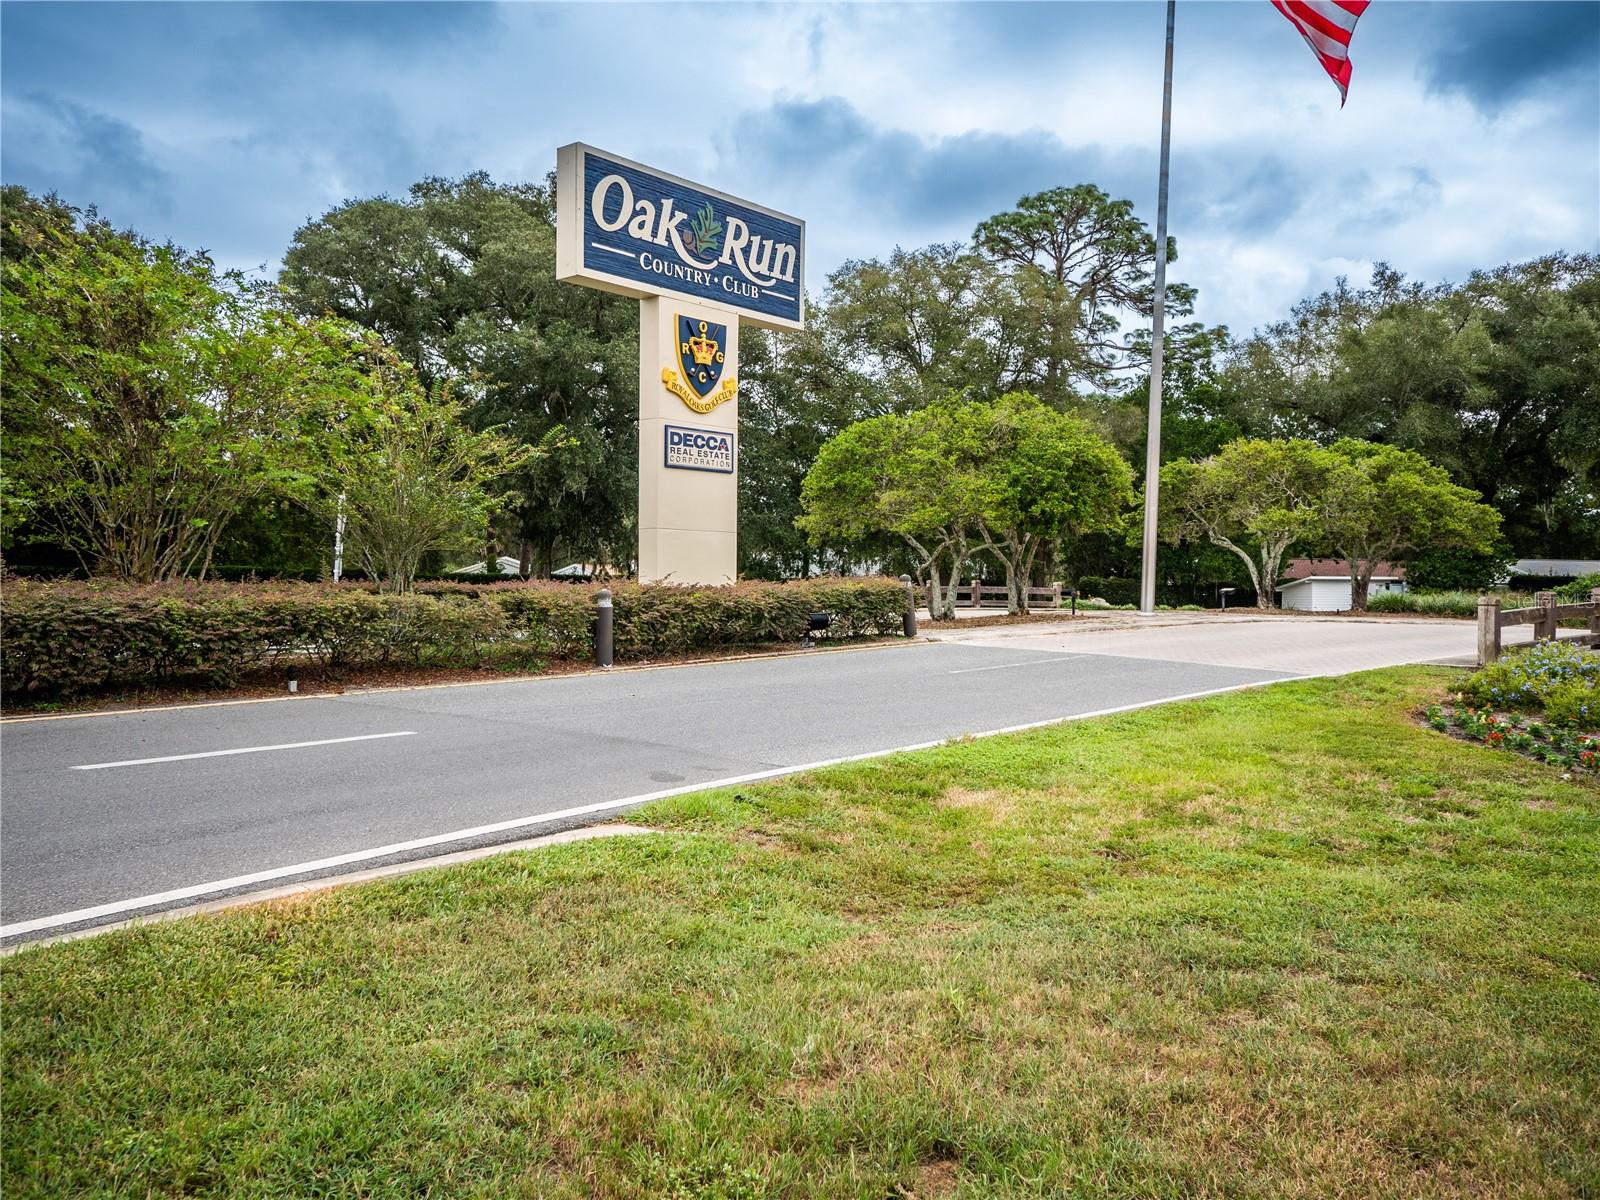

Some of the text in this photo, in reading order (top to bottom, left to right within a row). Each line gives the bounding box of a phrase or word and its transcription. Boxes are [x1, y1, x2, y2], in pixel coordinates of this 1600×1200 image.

[591, 174, 797, 286] Oak Run
[639, 252, 759, 299] COUNTRY CLUB
[682, 343, 690, 355] R
[699, 372, 707, 383] C
[669, 431, 729, 452] DECCA
[670, 446, 730, 461] REAL ESTATE
[669, 455, 730, 468] CORPORATION
